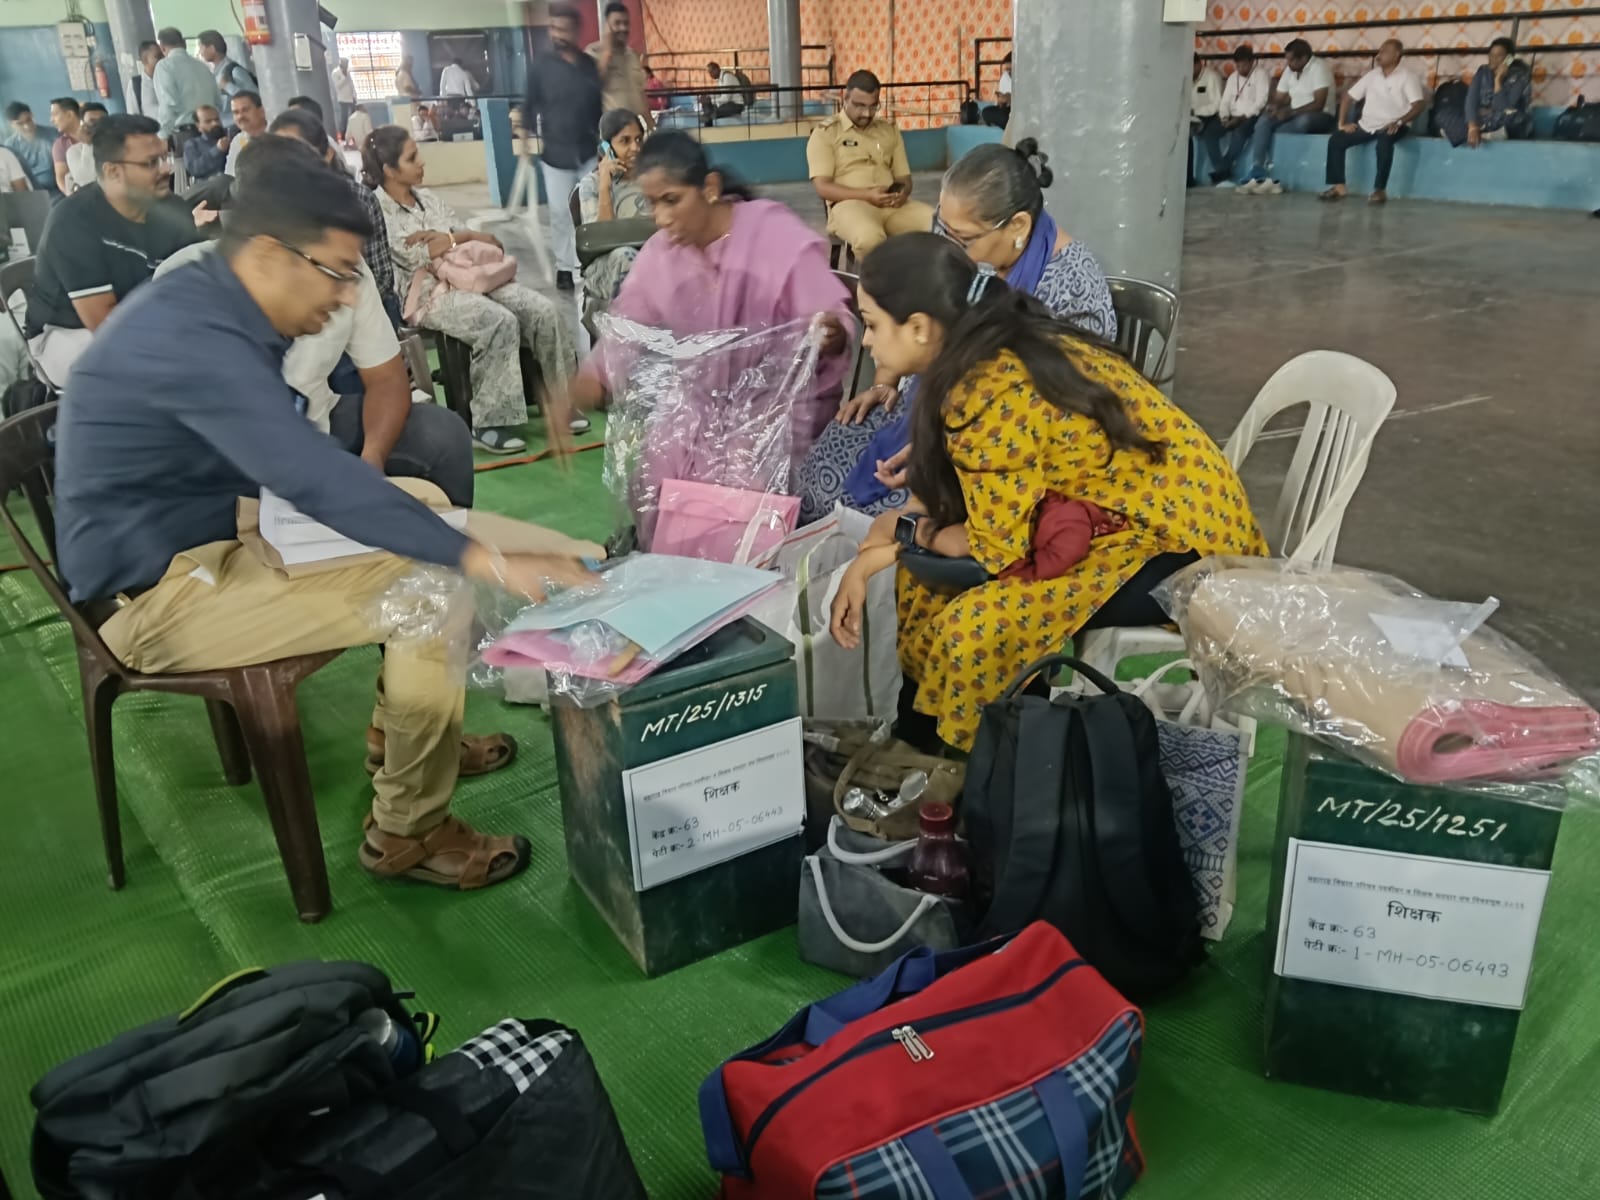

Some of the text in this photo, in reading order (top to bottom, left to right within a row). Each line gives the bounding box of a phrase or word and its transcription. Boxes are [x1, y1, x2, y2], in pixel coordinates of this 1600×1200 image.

[641, 684, 767, 742] MT/25/1315
[703, 780, 741, 802] शिक्षक
[1317, 797, 1508, 841] MT/25/1251
[1387, 900, 1442, 923] शिक्षक
[1353, 924, 1376, 939] 63
